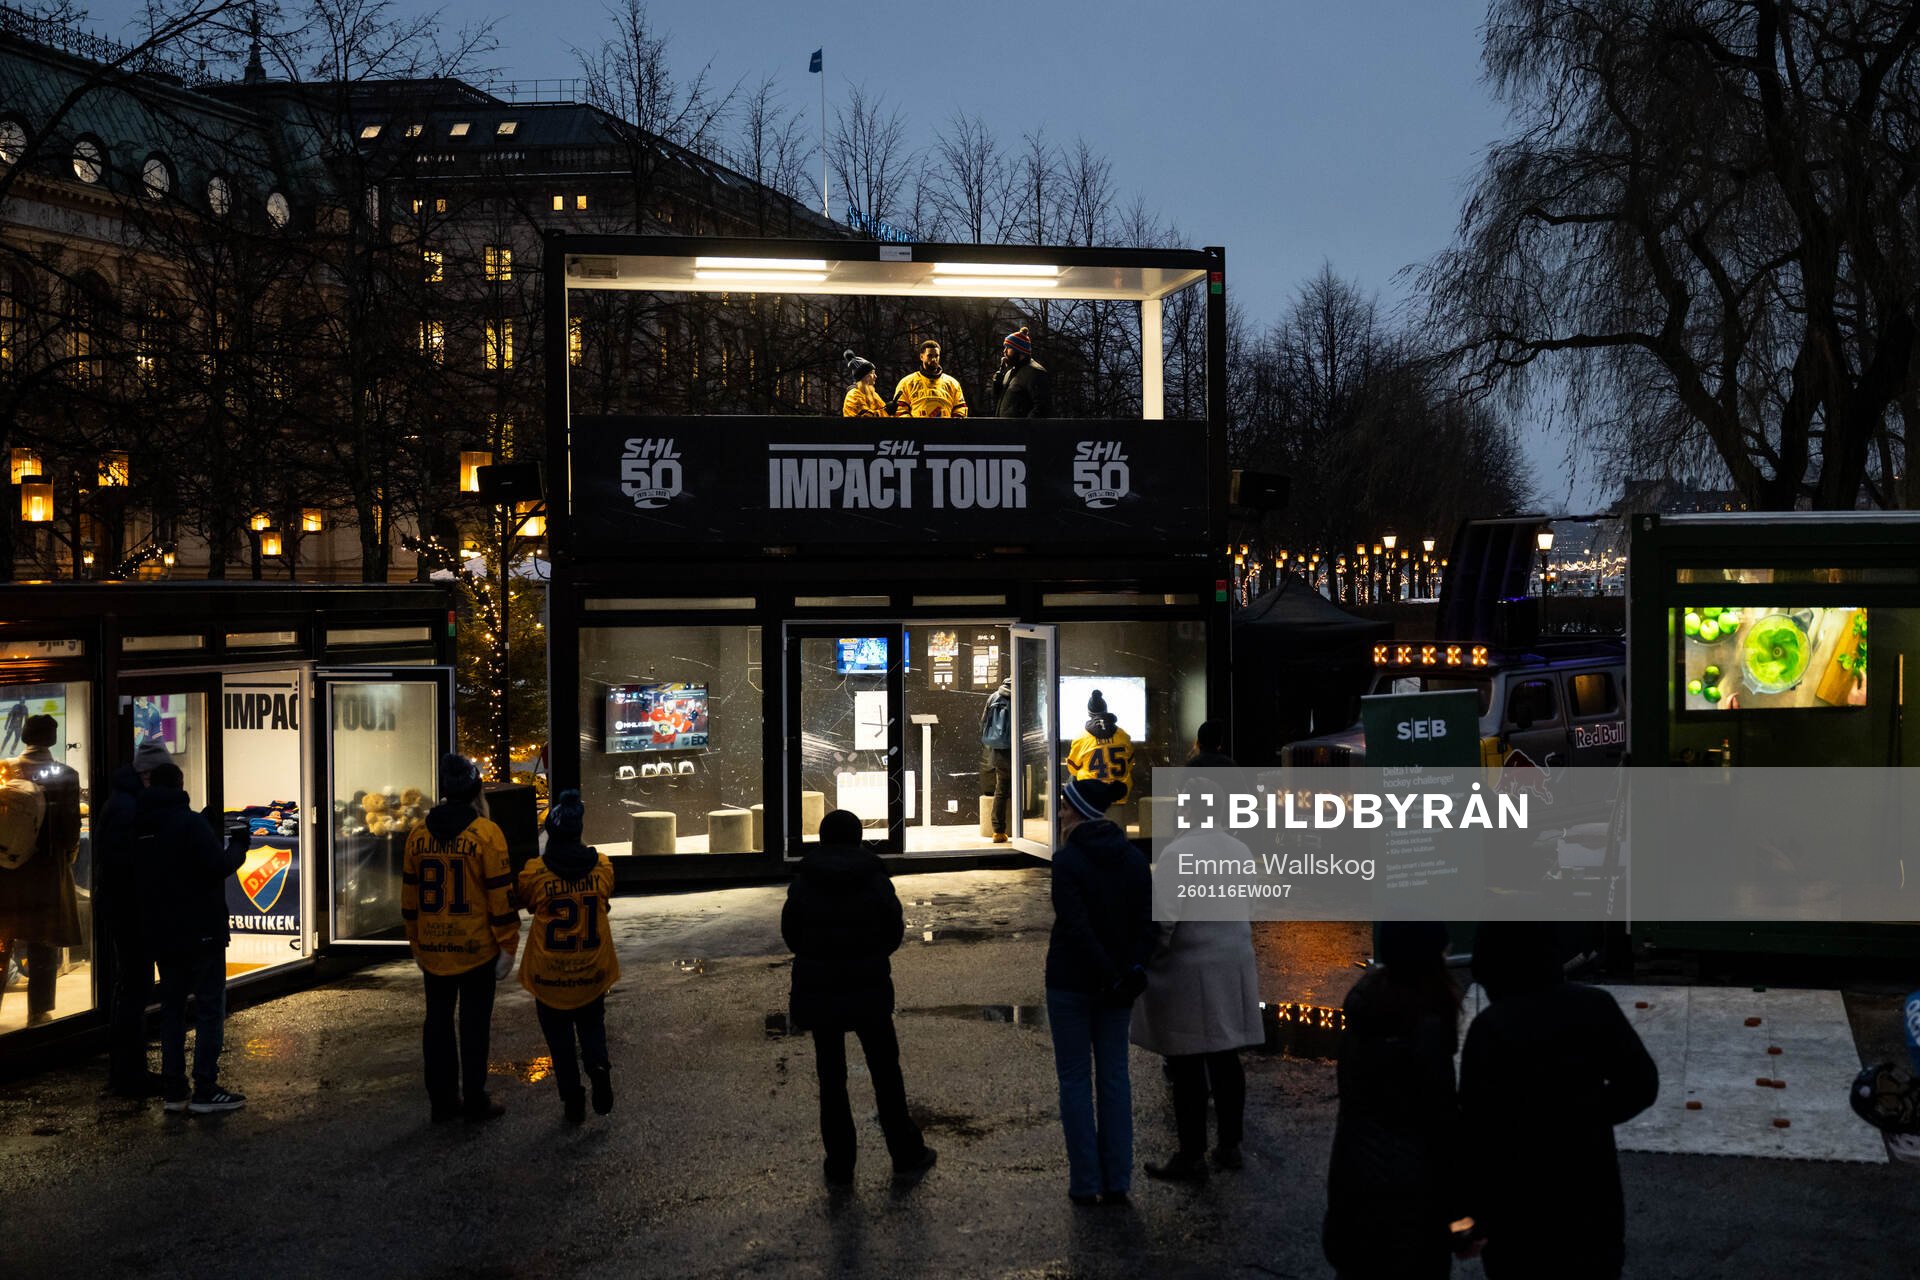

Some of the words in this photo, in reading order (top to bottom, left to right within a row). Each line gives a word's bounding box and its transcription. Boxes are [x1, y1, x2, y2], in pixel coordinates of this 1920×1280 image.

[621, 438, 682, 459] SHL
[877, 440, 921, 456] SHL
[1074, 441, 1129, 461] SHL
[621, 459, 682, 497] 50
[769, 458, 917, 509] IMPACT
[926, 458, 1026, 509] TOUR
[1073, 461, 1130, 498] 50
[1396, 718, 1447, 741] SEB
[1575, 725, 1601, 748] Red
[1600, 721, 1625, 745] Bull
[1090, 747, 1126, 778] 45
[1383, 778, 1411, 788] hockey
[247, 854, 286, 891] D.I.F.
[420, 858, 471, 914] 81
[545, 895, 600, 951] 21
